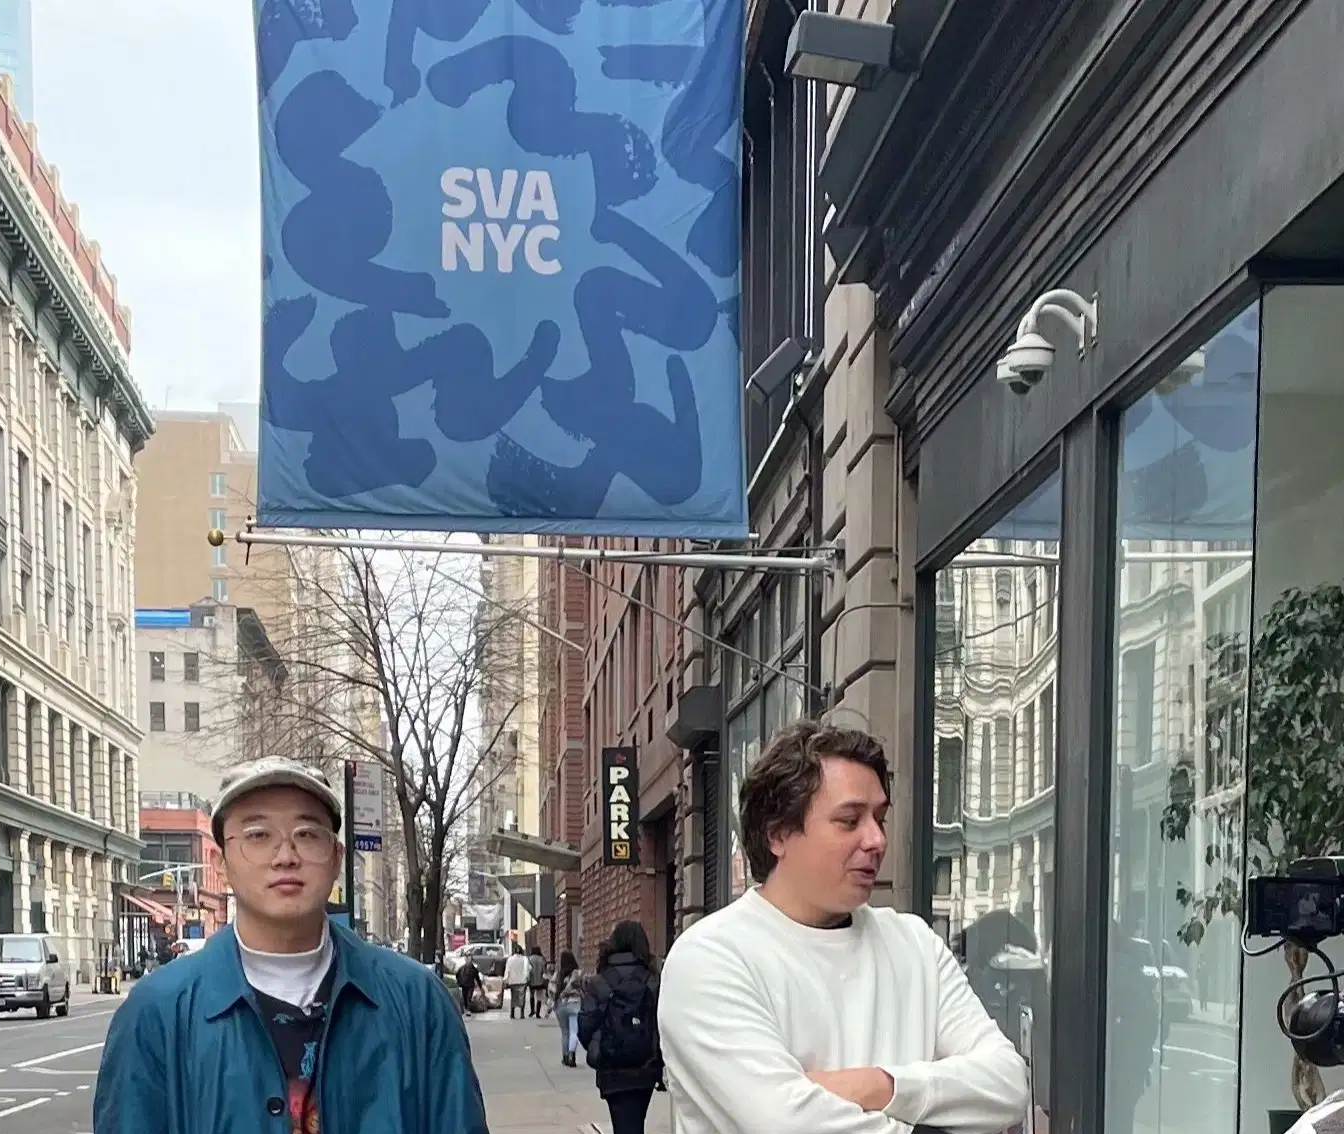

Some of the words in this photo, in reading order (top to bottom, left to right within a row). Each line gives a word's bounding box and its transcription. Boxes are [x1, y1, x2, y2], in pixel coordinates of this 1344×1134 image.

[440, 166, 559, 220] SVA
[441, 221, 562, 275] NYC
[609, 766, 631, 840] PARK
